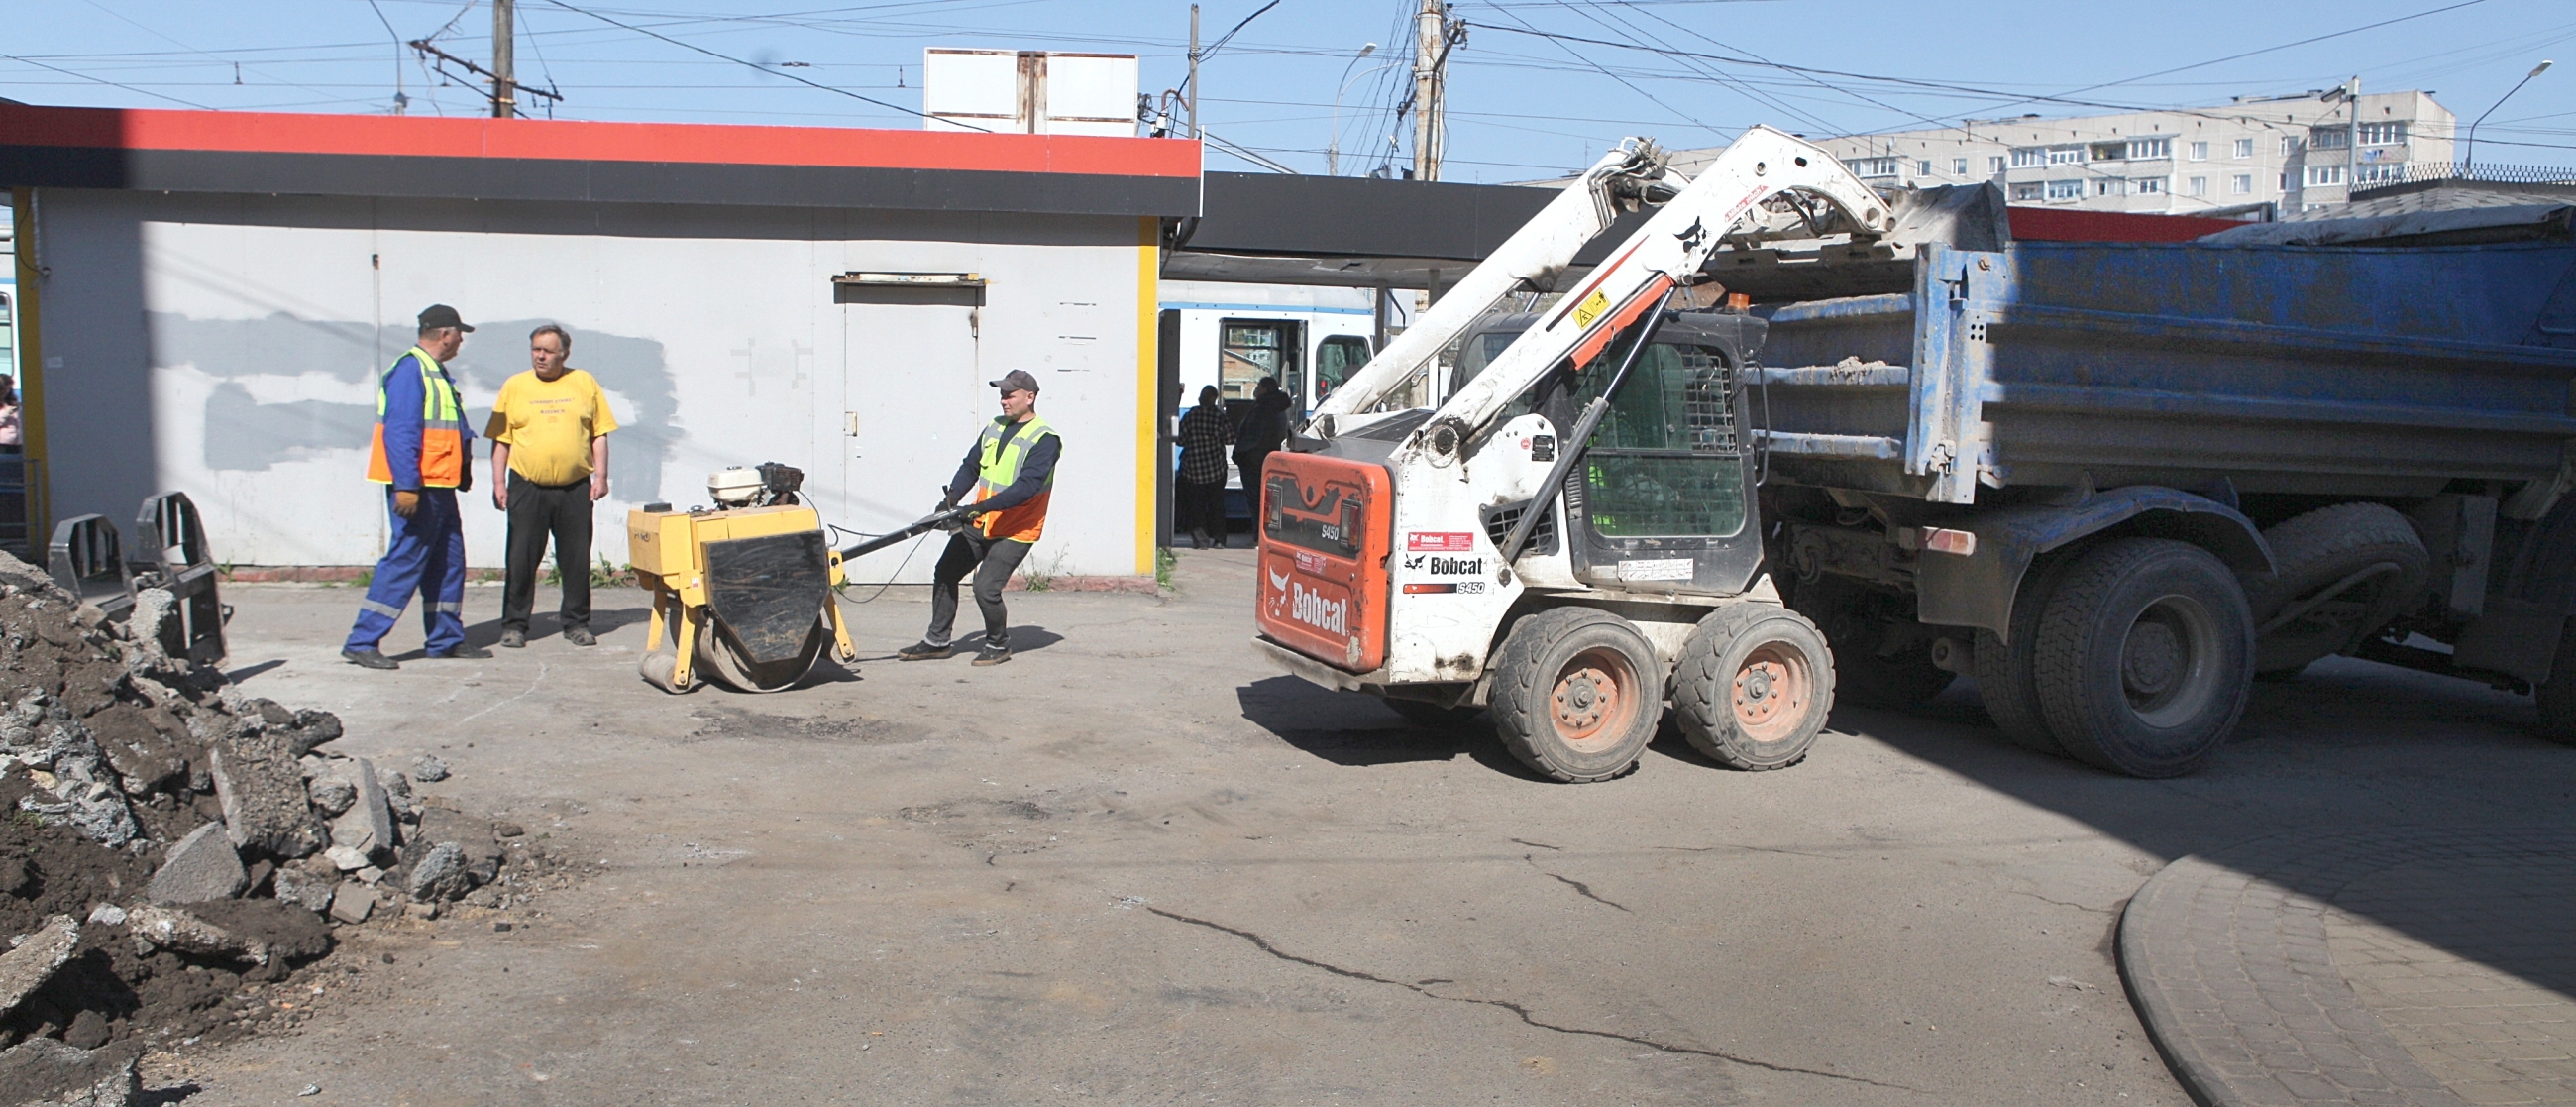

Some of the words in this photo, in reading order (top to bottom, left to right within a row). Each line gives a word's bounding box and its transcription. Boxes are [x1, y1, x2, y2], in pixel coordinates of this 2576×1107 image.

[1322, 524, 1340, 541] S450
[1430, 557, 1482, 575] Bobcat
[1458, 582, 1485, 594] S450
[1292, 582, 1347, 637] Bobcat
